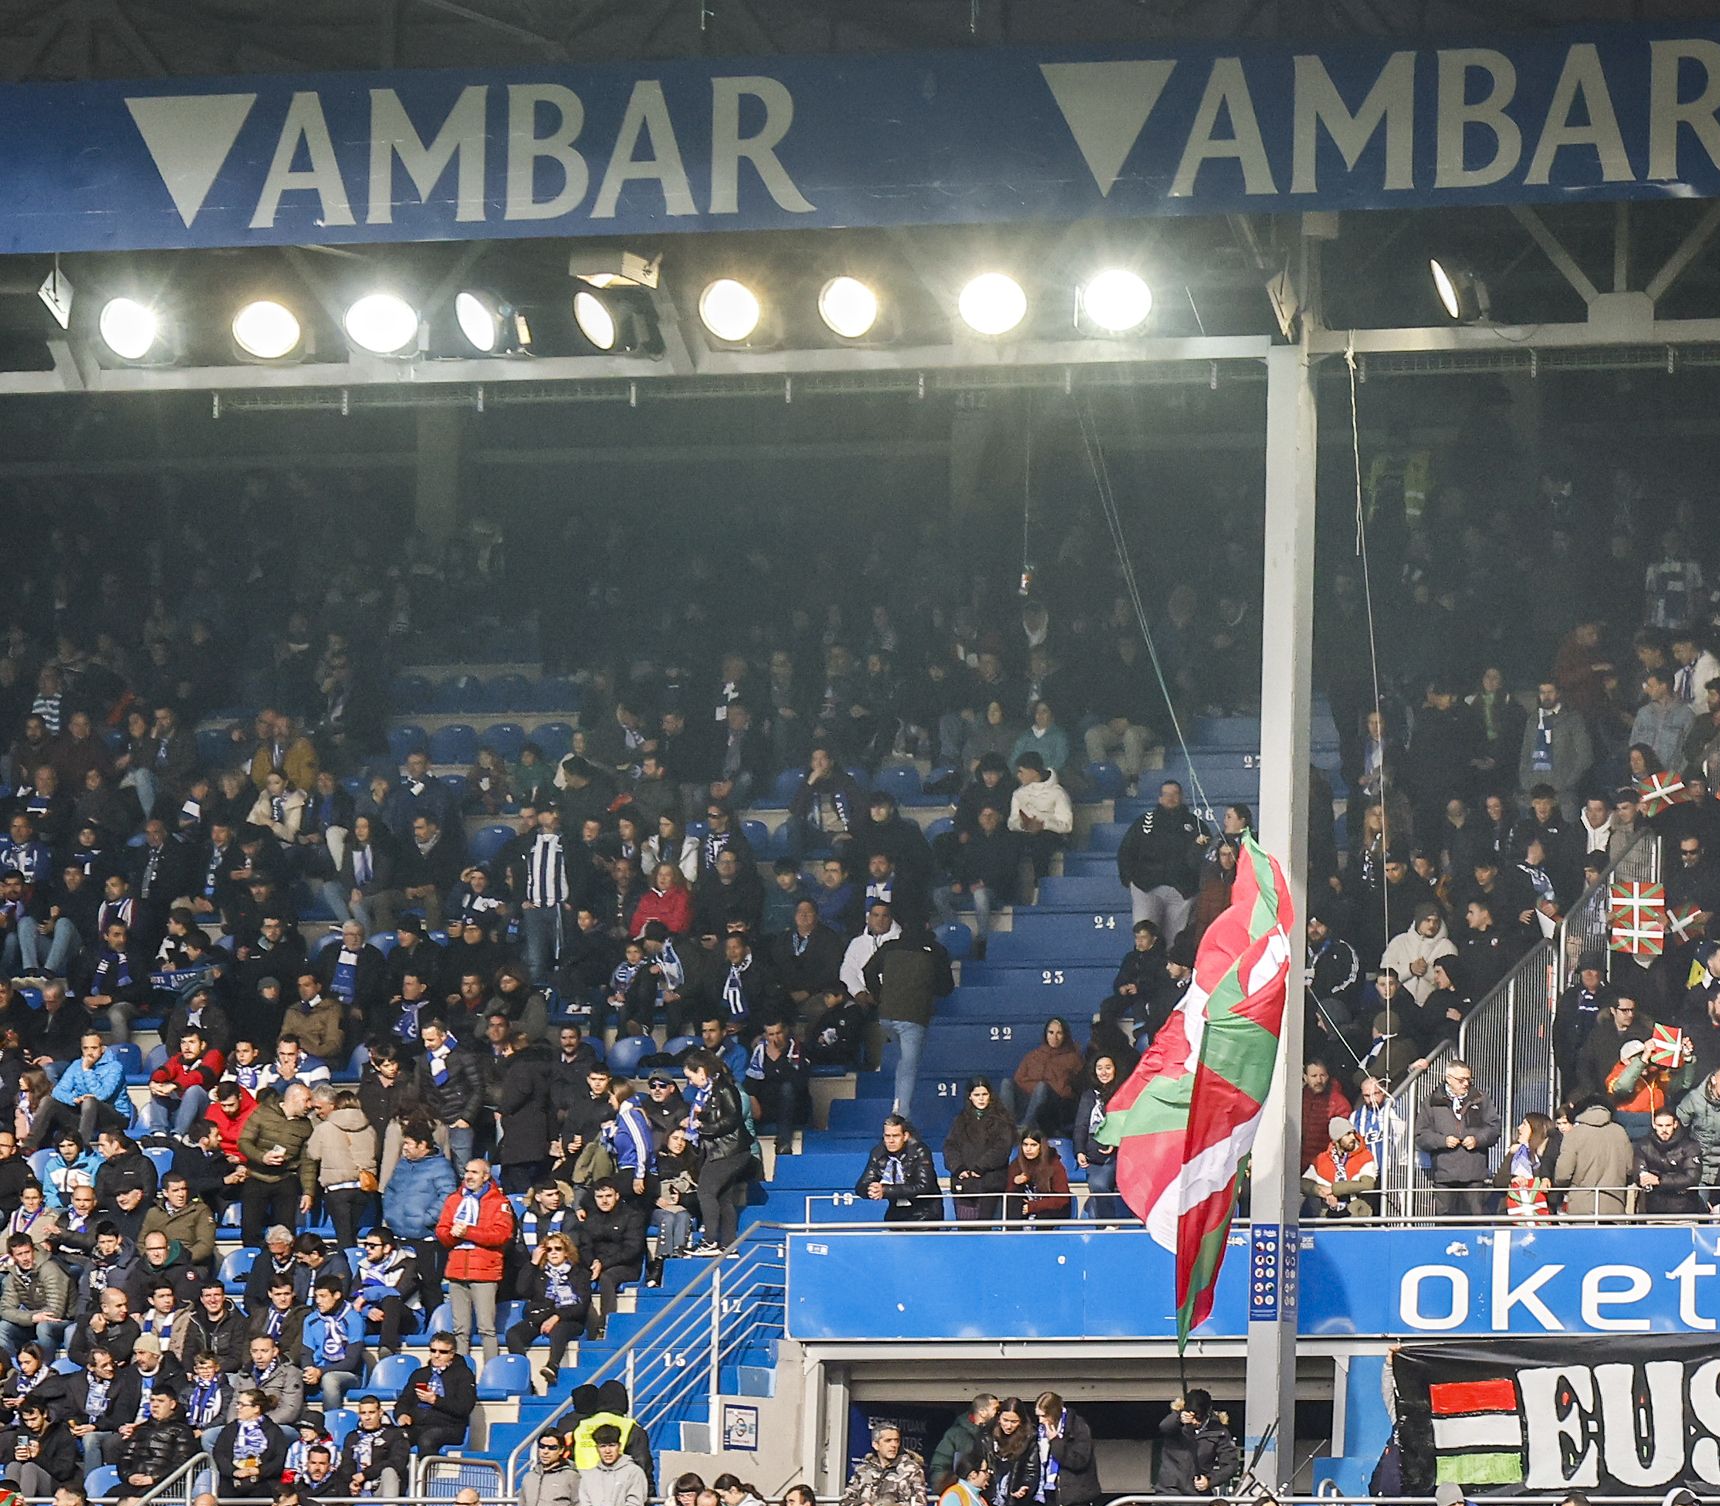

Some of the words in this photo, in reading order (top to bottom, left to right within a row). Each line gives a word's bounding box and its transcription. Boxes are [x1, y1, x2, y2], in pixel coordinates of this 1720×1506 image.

[249, 76, 817, 228] AMBAR
[1094, 916, 1116, 930] 24
[1043, 970, 1065, 985] 23
[990, 1027, 1012, 1041] 22
[938, 1083, 957, 1097] 21
